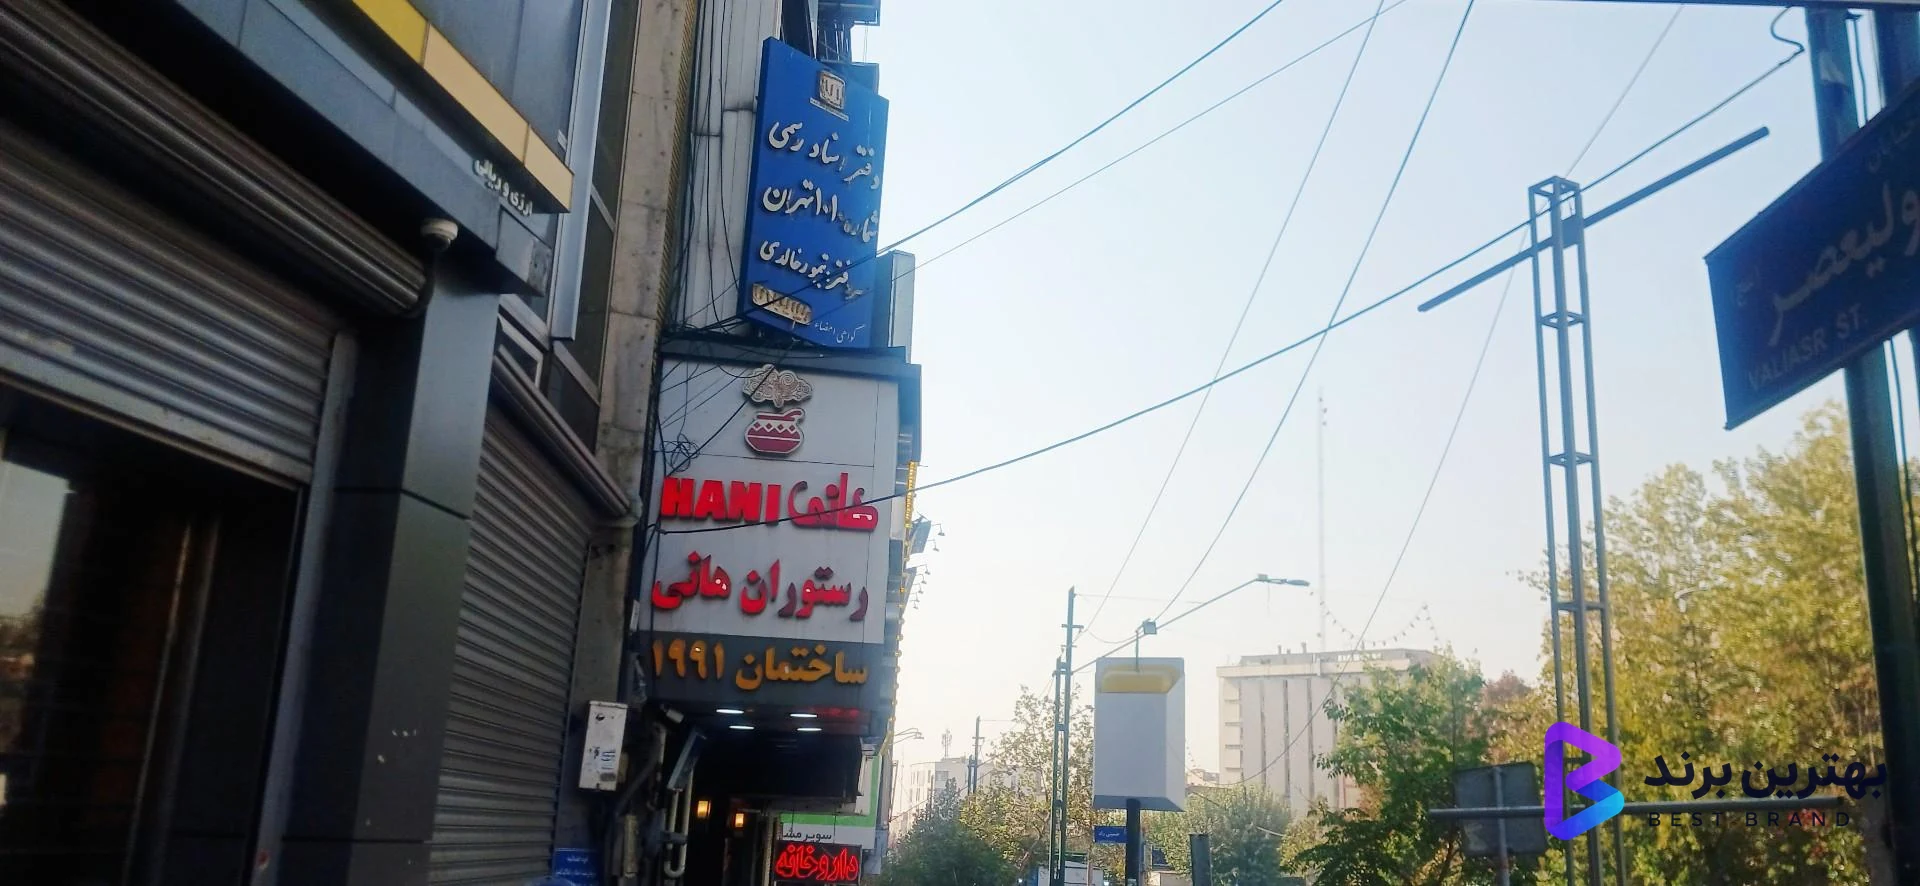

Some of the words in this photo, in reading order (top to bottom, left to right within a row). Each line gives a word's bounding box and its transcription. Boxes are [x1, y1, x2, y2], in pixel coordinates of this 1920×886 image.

[768, 121, 804, 152] رسمی
[843, 145, 880, 190] دفتر
[762, 179, 815, 215] تهران
[1768, 180, 1920, 347] ولیعصر
[1749, 327, 1828, 391] VALIASR
[661, 476, 782, 527] HANI
[651, 551, 732, 611] هانی
[739, 558, 869, 622] رستوران
[653, 638, 725, 680] ۱۹۹۱
[735, 643, 869, 691] ساختمان
[775, 844, 860, 881] داروخانه
